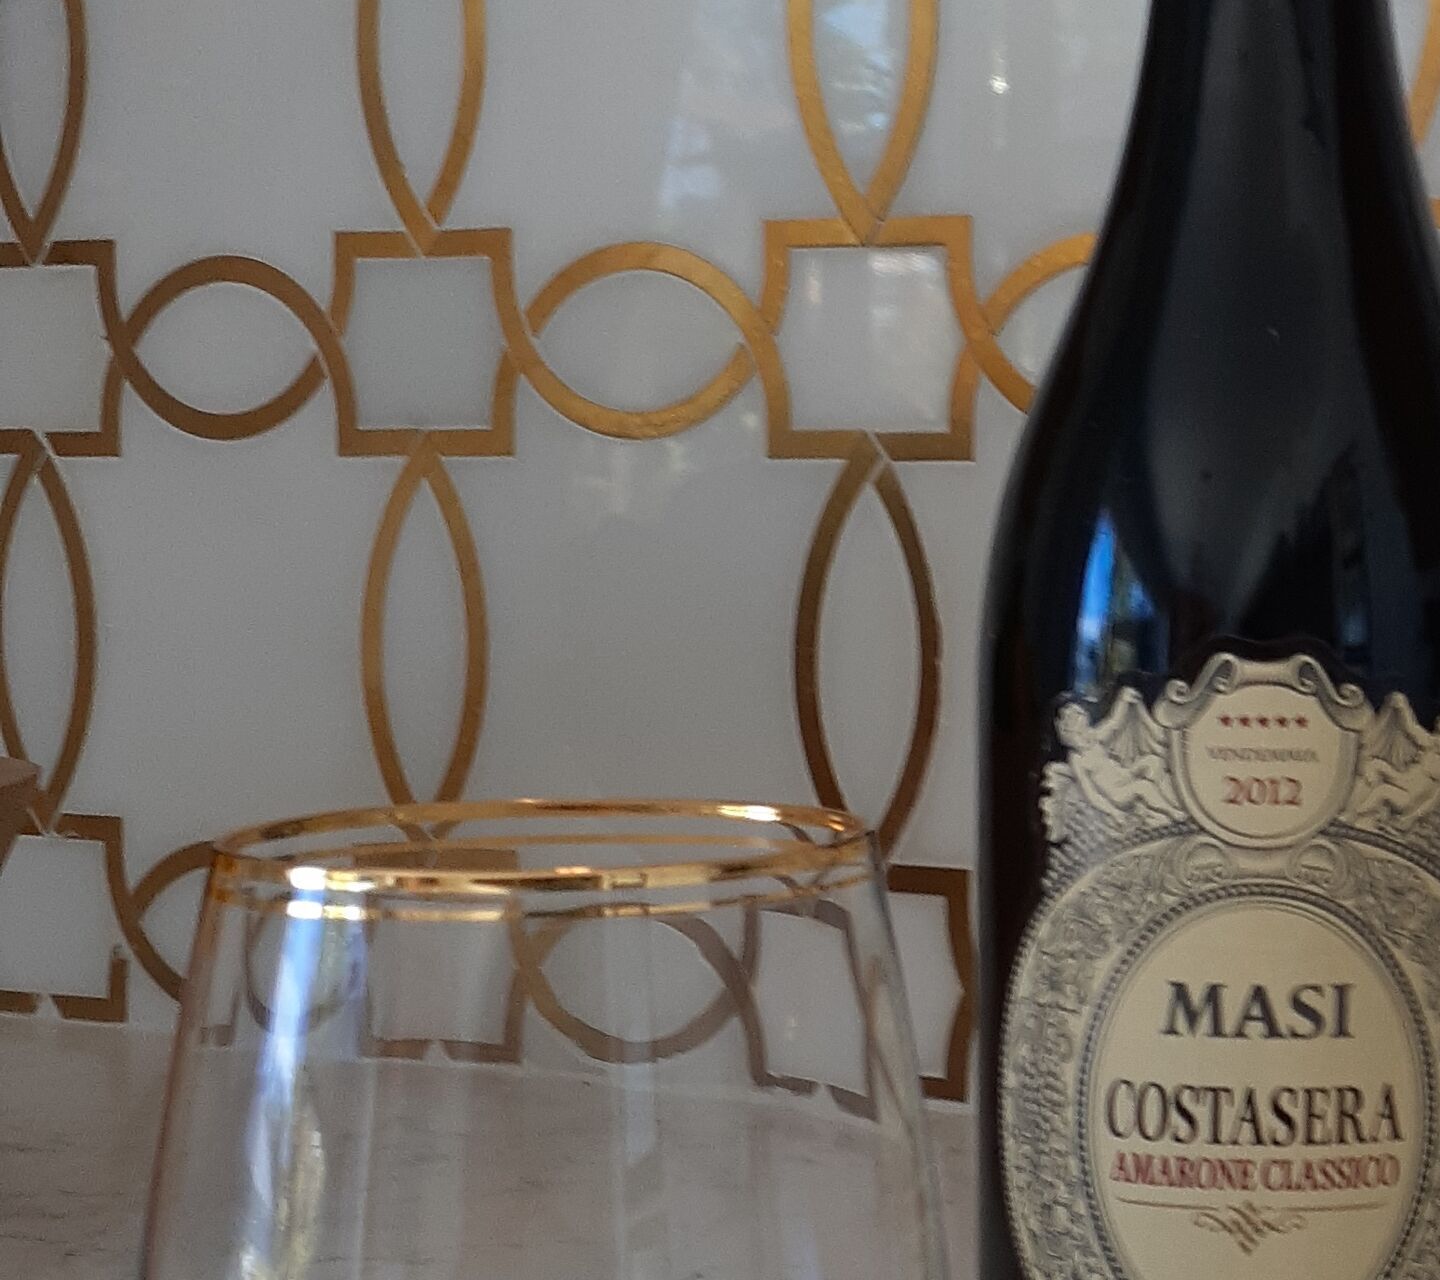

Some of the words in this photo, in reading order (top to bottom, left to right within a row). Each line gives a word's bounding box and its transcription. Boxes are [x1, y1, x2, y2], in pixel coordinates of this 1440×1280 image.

[1222, 776, 1303, 806] 2012
[1161, 980, 1356, 1040] MASI
[1105, 1078, 1405, 1147] COSTASERA
[1109, 1151, 1257, 1191] AMARONE
[1259, 1153, 1400, 1193] CLASSICO
